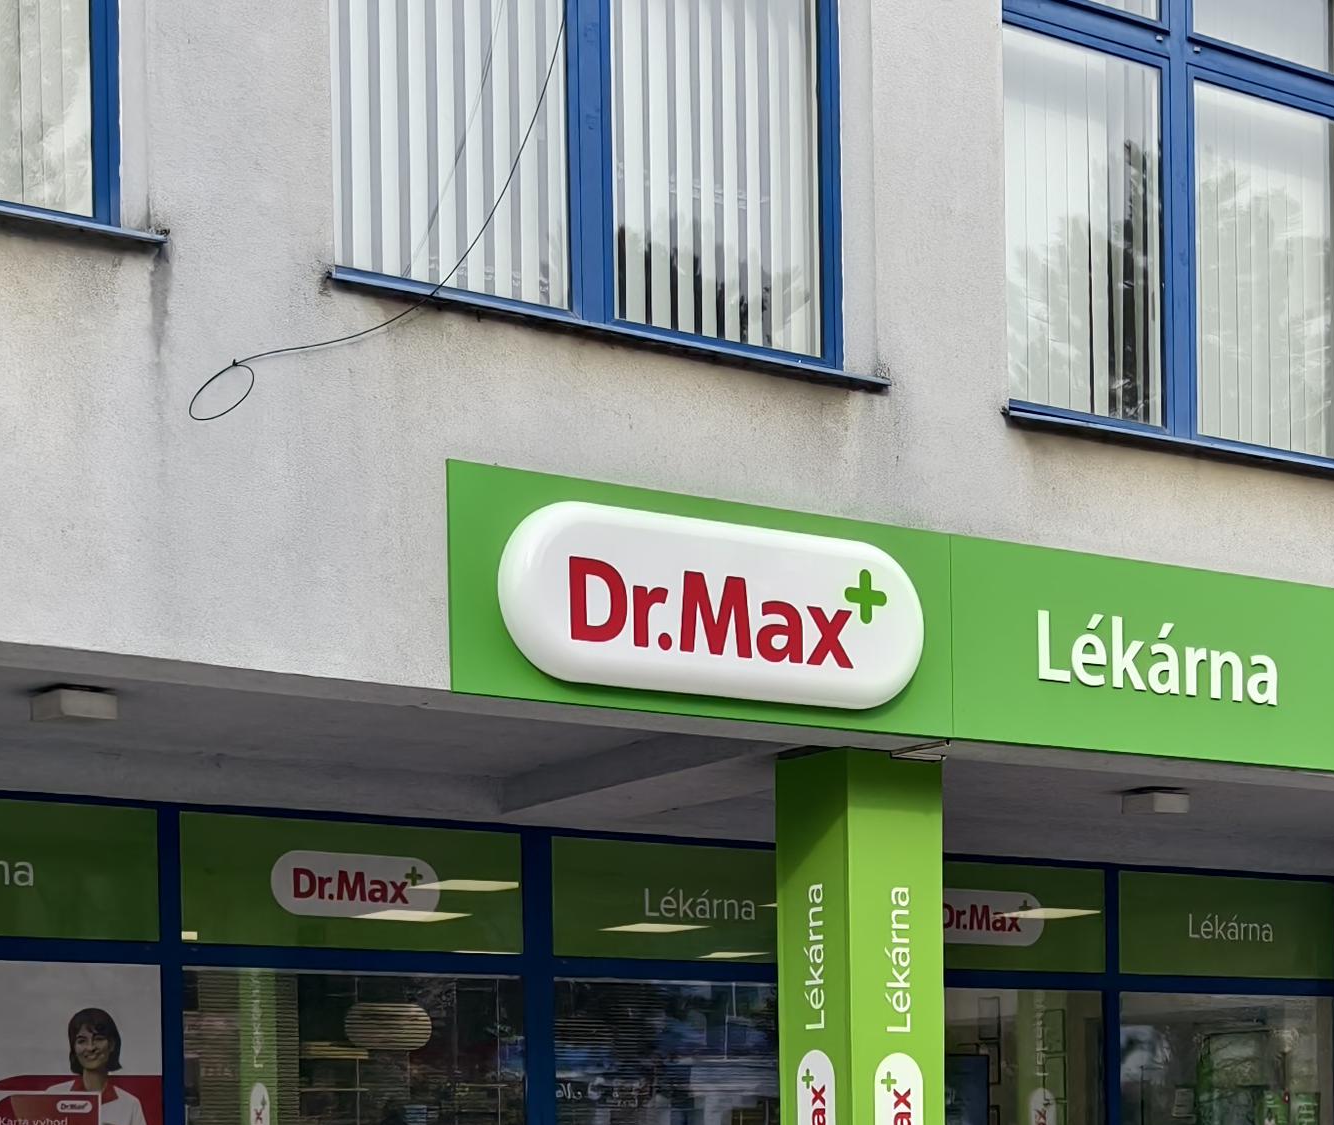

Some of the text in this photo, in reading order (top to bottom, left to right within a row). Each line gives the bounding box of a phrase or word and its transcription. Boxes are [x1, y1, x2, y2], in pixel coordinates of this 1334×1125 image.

[1036, 610, 1280, 706] Lékárna
[643, 888, 756, 921] Lékárna
[1188, 913, 1273, 943] Lékárna
[803, 883, 825, 1030] Lékárna
[885, 886, 911, 1033] Lékárna
